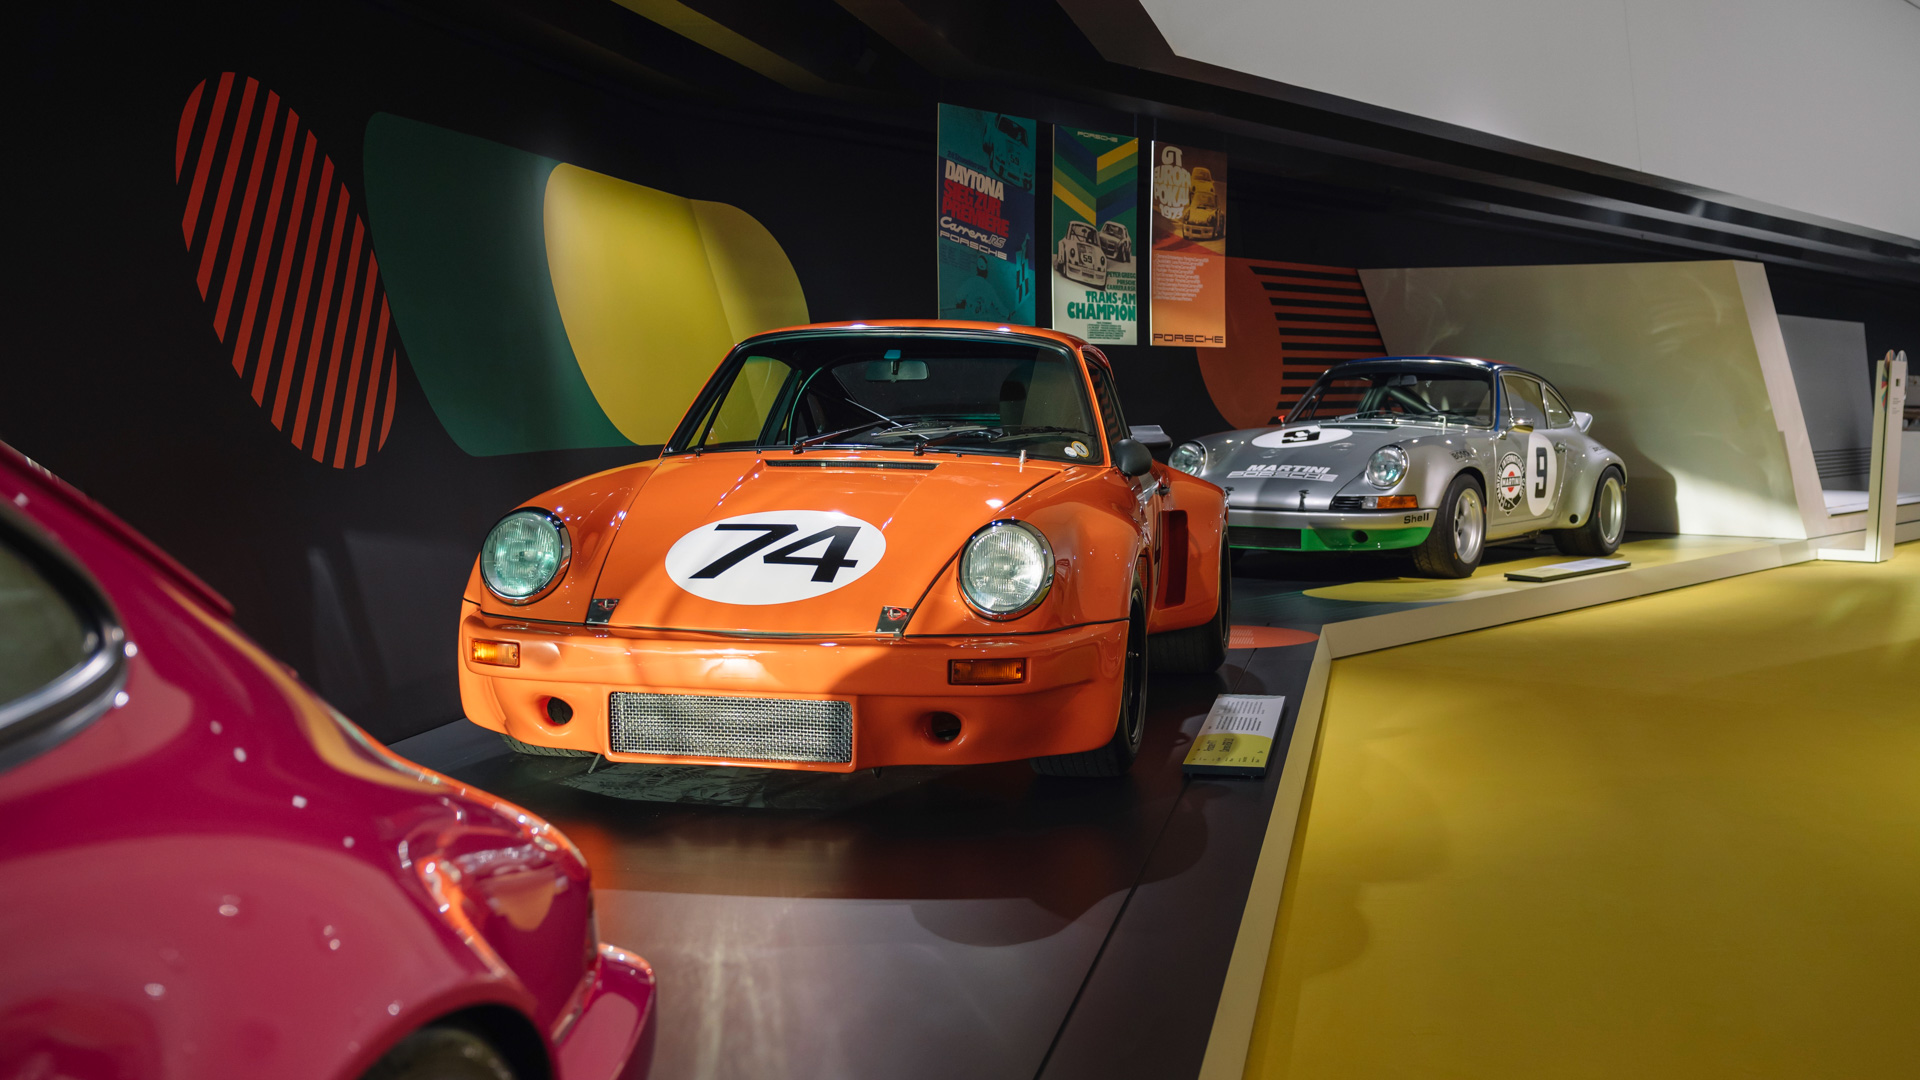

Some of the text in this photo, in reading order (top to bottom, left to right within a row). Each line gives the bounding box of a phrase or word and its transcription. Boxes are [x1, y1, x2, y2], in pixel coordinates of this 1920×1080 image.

[1077, 131, 1118, 143] PORSCHE
[1162, 145, 1183, 167] GT
[945, 160, 1004, 201] DAYTONA
[944, 179, 1002, 218] SIEG ZUR
[1154, 183, 1190, 208] POKAL
[942, 197, 1010, 238] PREMIERE
[940, 216, 1007, 249] Carrera RS
[940, 230, 1007, 260] PORSCHE
[1083, 254, 1093, 264] 59
[1067, 302, 1136, 321] CHAMPION
[1153, 333, 1224, 344] PORSCHE
[1281, 429, 1321, 444] 9
[1226, 471, 1339, 483] PORSCHE
[1246, 464, 1331, 474] MARTINI
[1534, 447, 1548, 499] 9
[1403, 512, 1430, 525] Shell
[688, 524, 862, 583] 74
